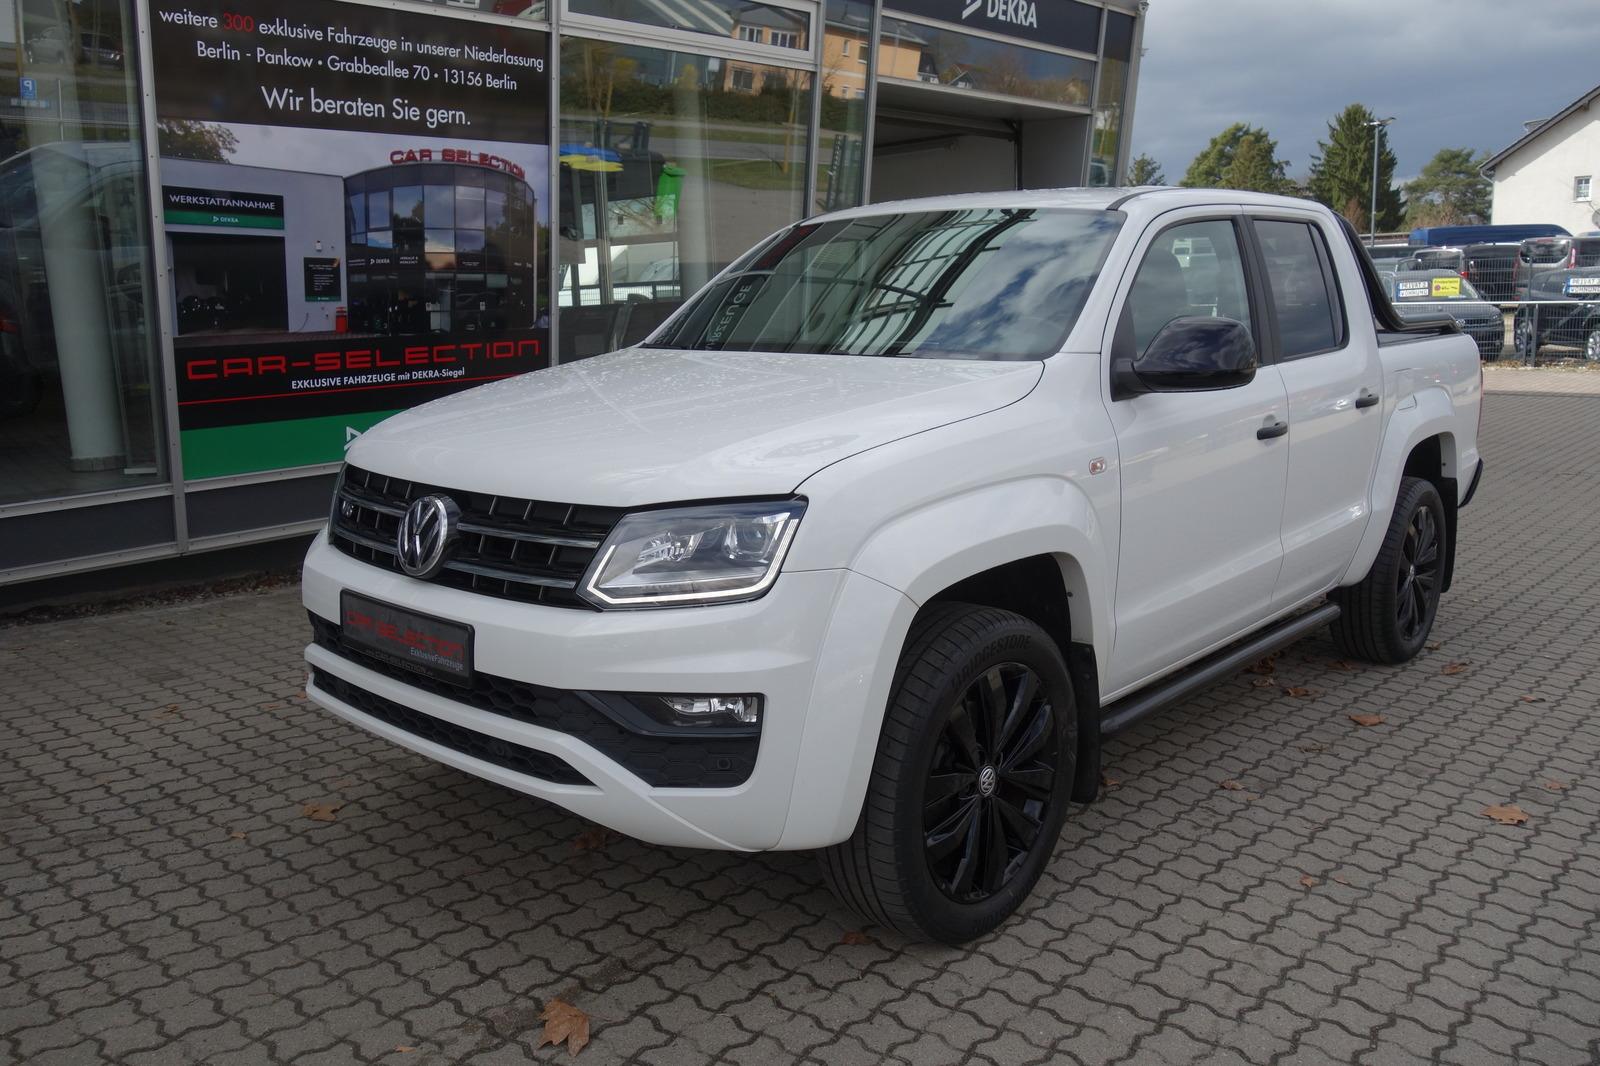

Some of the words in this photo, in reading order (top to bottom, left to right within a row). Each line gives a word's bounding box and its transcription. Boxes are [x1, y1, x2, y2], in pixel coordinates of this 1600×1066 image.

[987, 0, 1038, 28] DEKRA
[159, 9, 218, 29] weitere
[223, 12, 254, 33] 300
[259, 18, 323, 41] exklusive
[327, 27, 397, 53] Fahrzeuge
[401, 37, 412, 52] in
[417, 43, 461, 59] unserer
[465, 45, 544, 72] Niederlassung
[197, 41, 240, 61] Berlin
[257, 47, 313, 68] Pankow
[327, 56, 409, 79] Grabbeallee
[413, 65, 430, 81] 70
[443, 68, 482, 87] 13156
[486, 74, 517, 90] Berlin
[261, 86, 303, 112] Wir
[311, 88, 385, 118] beraten
[392, 98, 420, 121] Sie
[426, 108, 471, 128] gern.
[389, 149, 432, 165] CAR
[441, 148, 525, 179] SELECTION
[169, 194, 276, 211] WERKSTATTANNAHME
[186, 339, 541, 380] CAR-SELECTION
[291, 376, 341, 390] EXKLUSIVE
[343, 372, 395, 385] FAHRZEUGE
[397, 371, 410, 381] mit
[412, 366, 465, 380] DEKRA-Siegel
